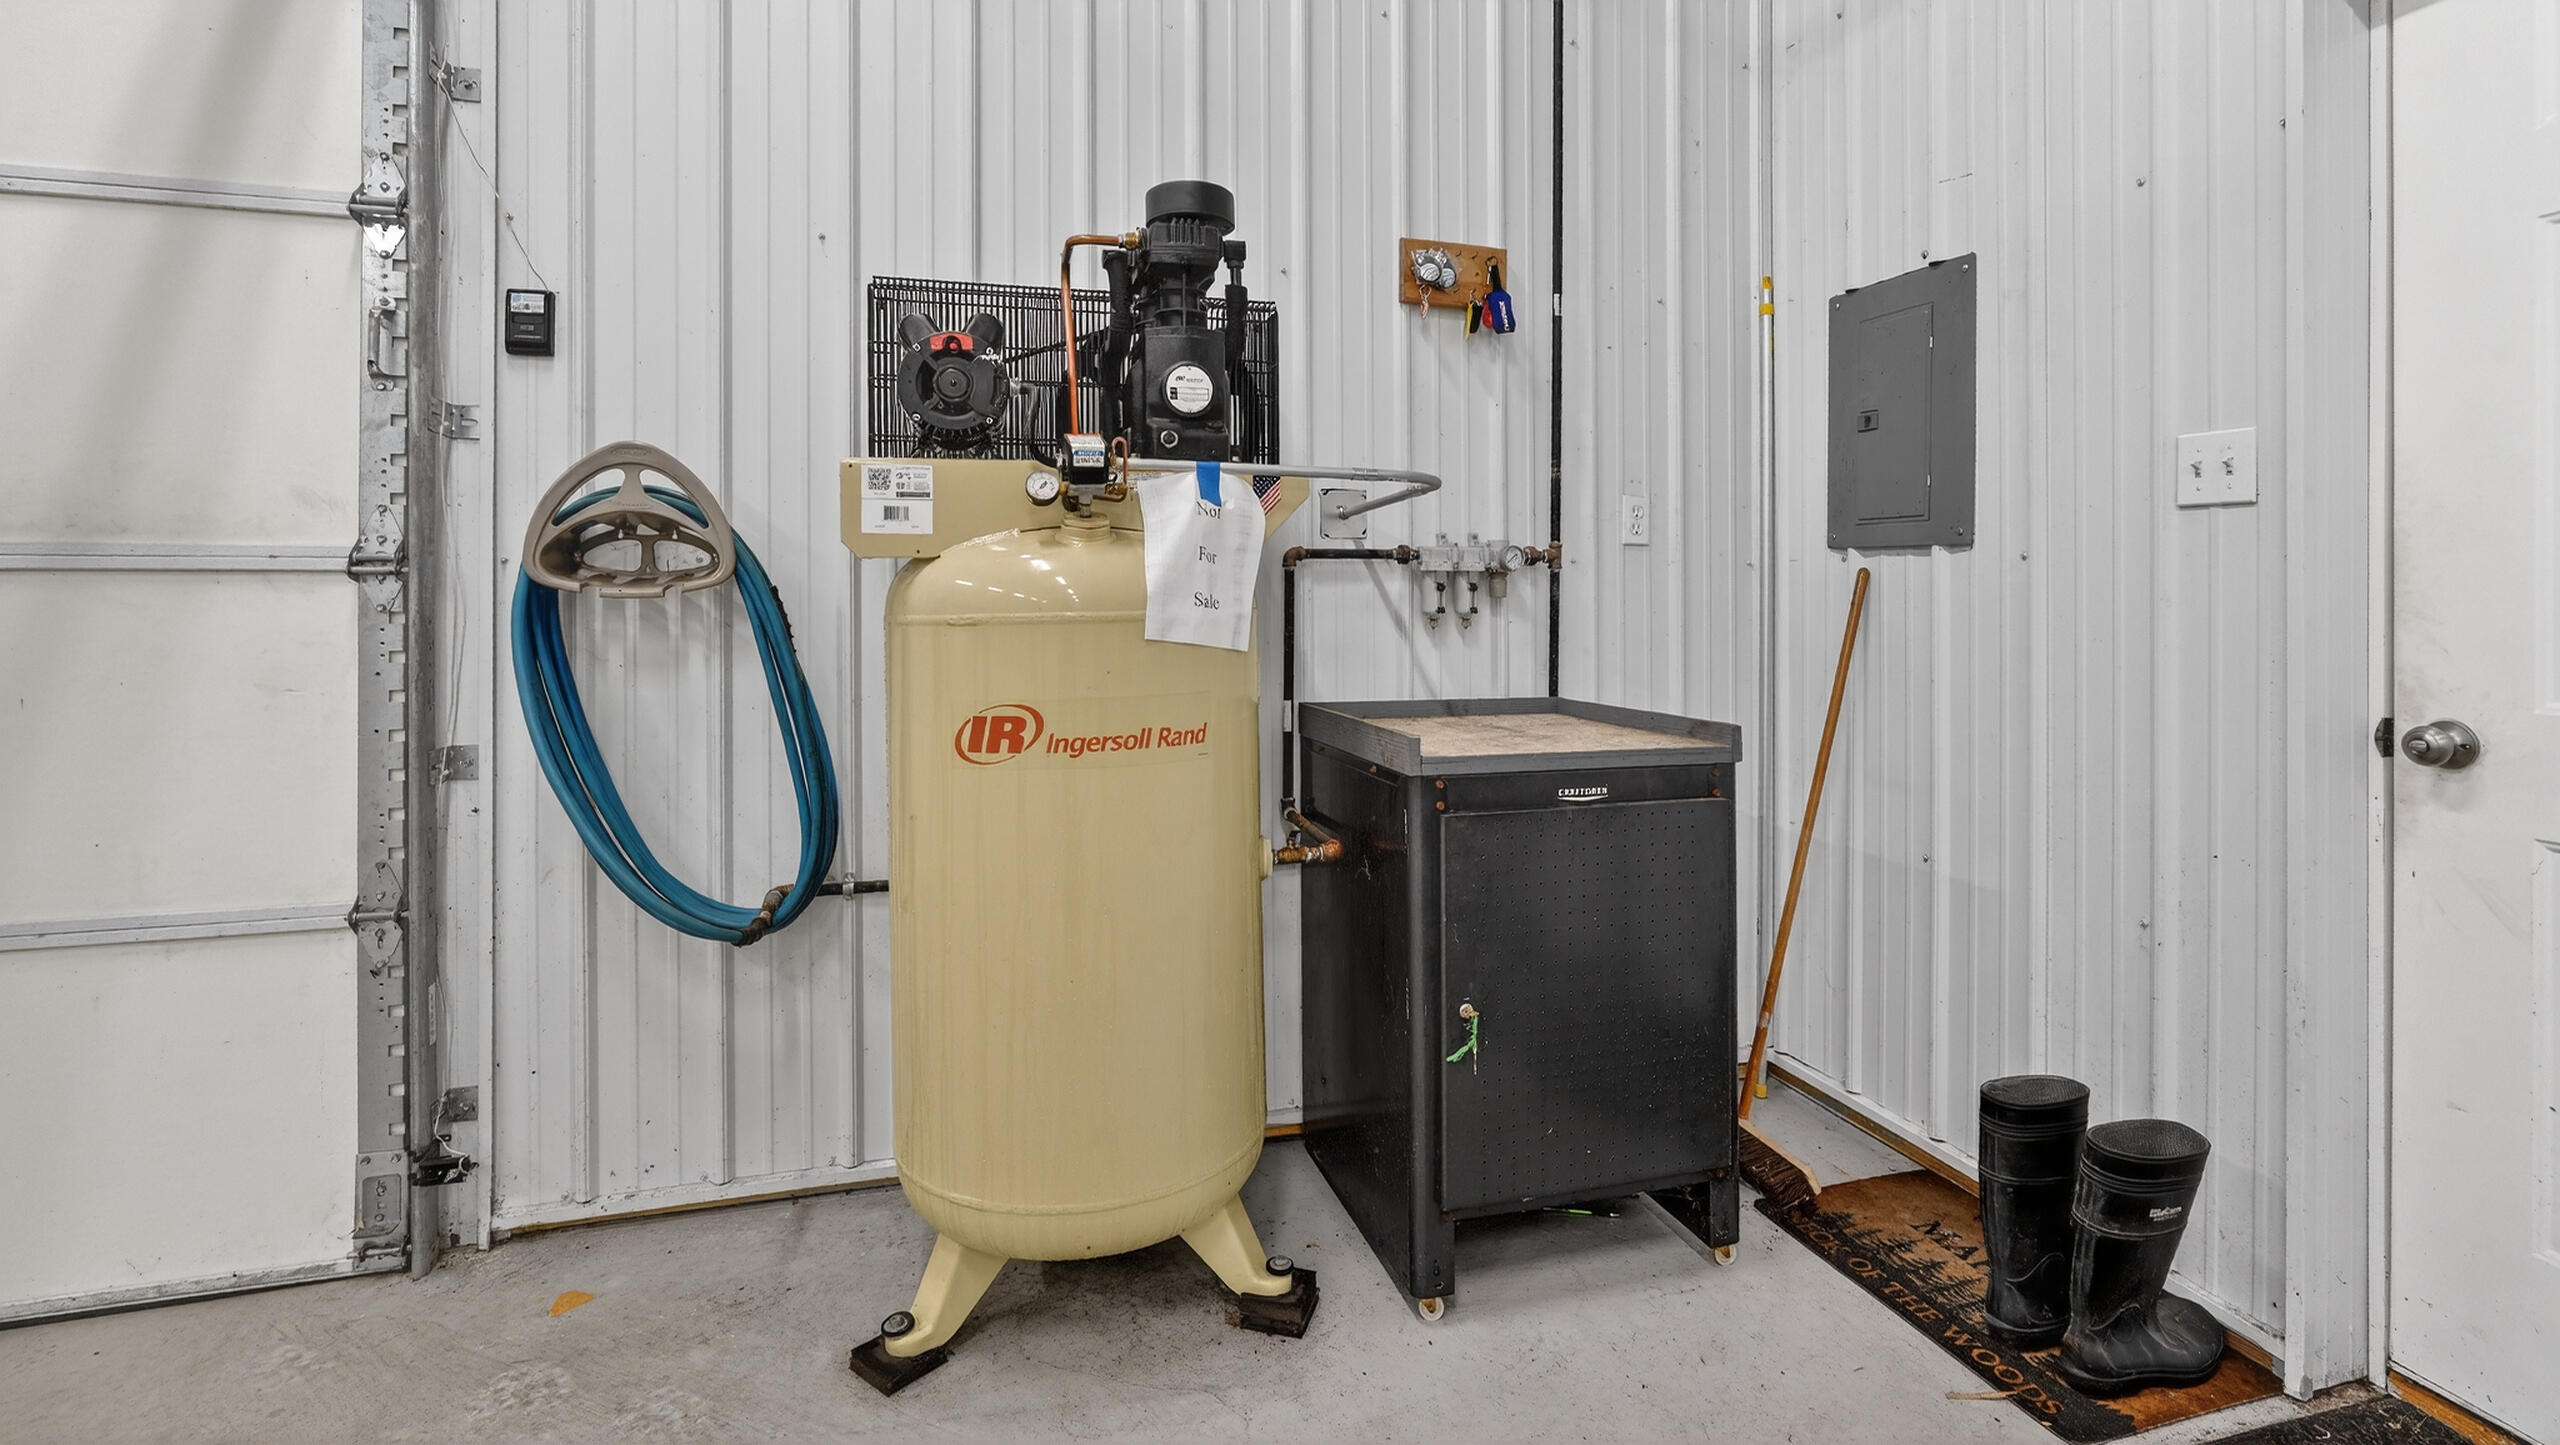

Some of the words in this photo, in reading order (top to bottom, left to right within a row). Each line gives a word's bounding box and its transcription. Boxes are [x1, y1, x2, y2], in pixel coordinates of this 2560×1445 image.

[1198, 545, 1217, 565] For
[1193, 591, 1221, 610] Sale
[967, 715, 1027, 754] IR
[1046, 727, 1153, 759] Ingersoll
[1157, 721, 1208, 748] Rand
[1848, 1257, 1888, 1279] OF
[1880, 1281, 1944, 1323] THE
[1944, 1324, 2065, 1414] WOODS
